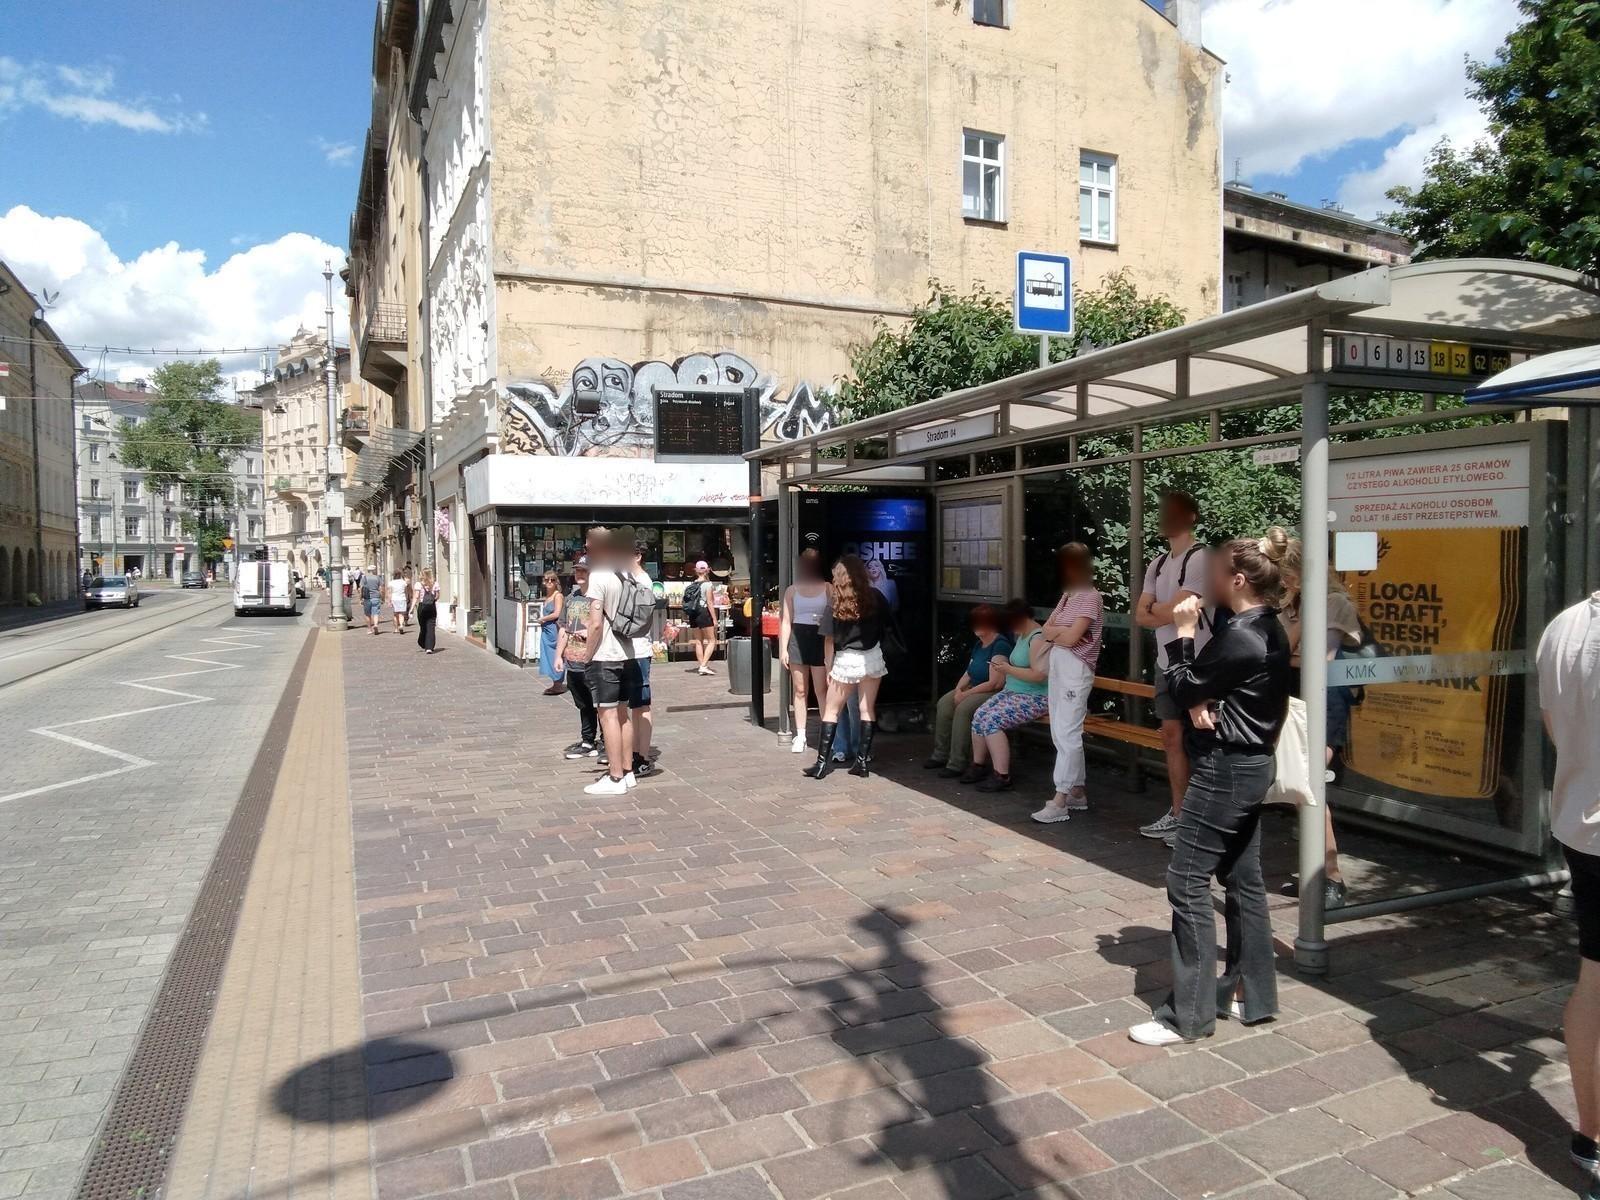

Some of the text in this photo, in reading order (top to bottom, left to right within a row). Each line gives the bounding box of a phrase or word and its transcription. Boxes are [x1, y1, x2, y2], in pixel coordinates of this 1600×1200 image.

[1350, 344, 1358, 360] 0
[1373, 345, 1381, 361] 6
[1396, 348, 1403, 363] 8
[1414, 350, 1425, 365] 13
[1434, 351, 1445, 367] 18
[1455, 353, 1466, 368] 52
[1474, 355, 1486, 370] 62
[926, 430, 949, 443] Stradom
[1346, 472, 1356, 480] 1/2
[1358, 470, 1381, 479] LITRA
[1384, 467, 1405, 477] PIWA
[1407, 464, 1448, 475] ZAWIERA
[1451, 463, 1461, 472] 25
[1347, 480, 1390, 490] CZYSTEGO
[1392, 477, 1440, 487] ALKOHOLU
[1354, 498, 1494, 512] SPRZEDAŻ ALKOHOLU OSOBOM
[1350, 514, 1362, 523] DO
[1364, 514, 1379, 522] LAT
[1392, 512, 1413, 521] JEST
[1370, 582, 1443, 603] LOCAL
[1370, 602, 1447, 628] CRAFT,
[1370, 622, 1439, 645] FRESH
[1345, 663, 1377, 679] KMK
